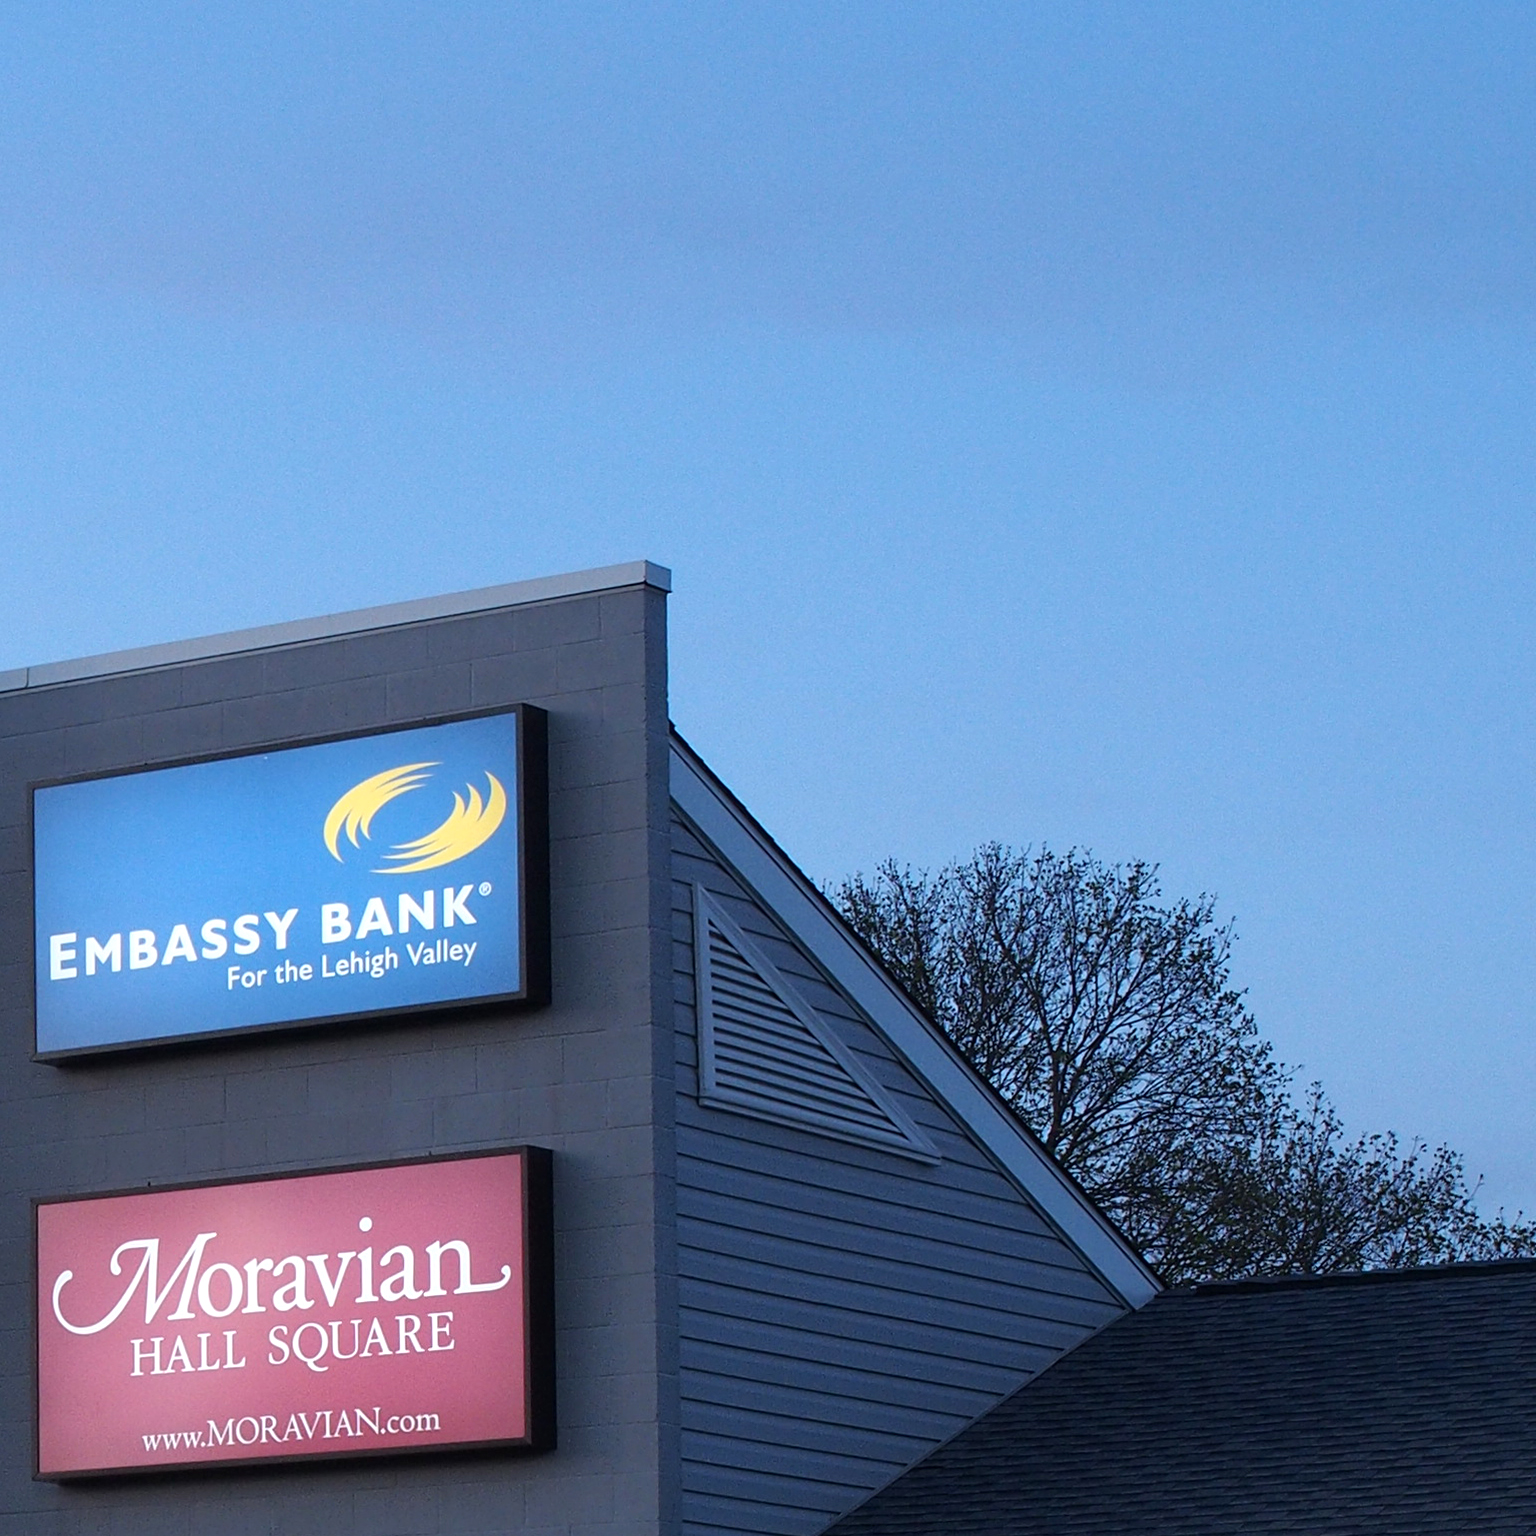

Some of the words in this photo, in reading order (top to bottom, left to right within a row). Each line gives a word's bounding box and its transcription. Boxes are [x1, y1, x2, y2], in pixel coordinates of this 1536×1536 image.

[48, 908, 299, 982] EMBASSY
[319, 883, 477, 945] BANK
[226, 963, 268, 991] For
[273, 957, 313, 983] the
[319, 950, 399, 979] Lehigh
[404, 938, 478, 968] Valley
[52, 1216, 512, 1334] Moravian
[130, 1330, 246, 1377] HALL
[267, 1311, 456, 1372] SQUARE
[141, 1406, 442, 1453] www.MORAVIAN.com
